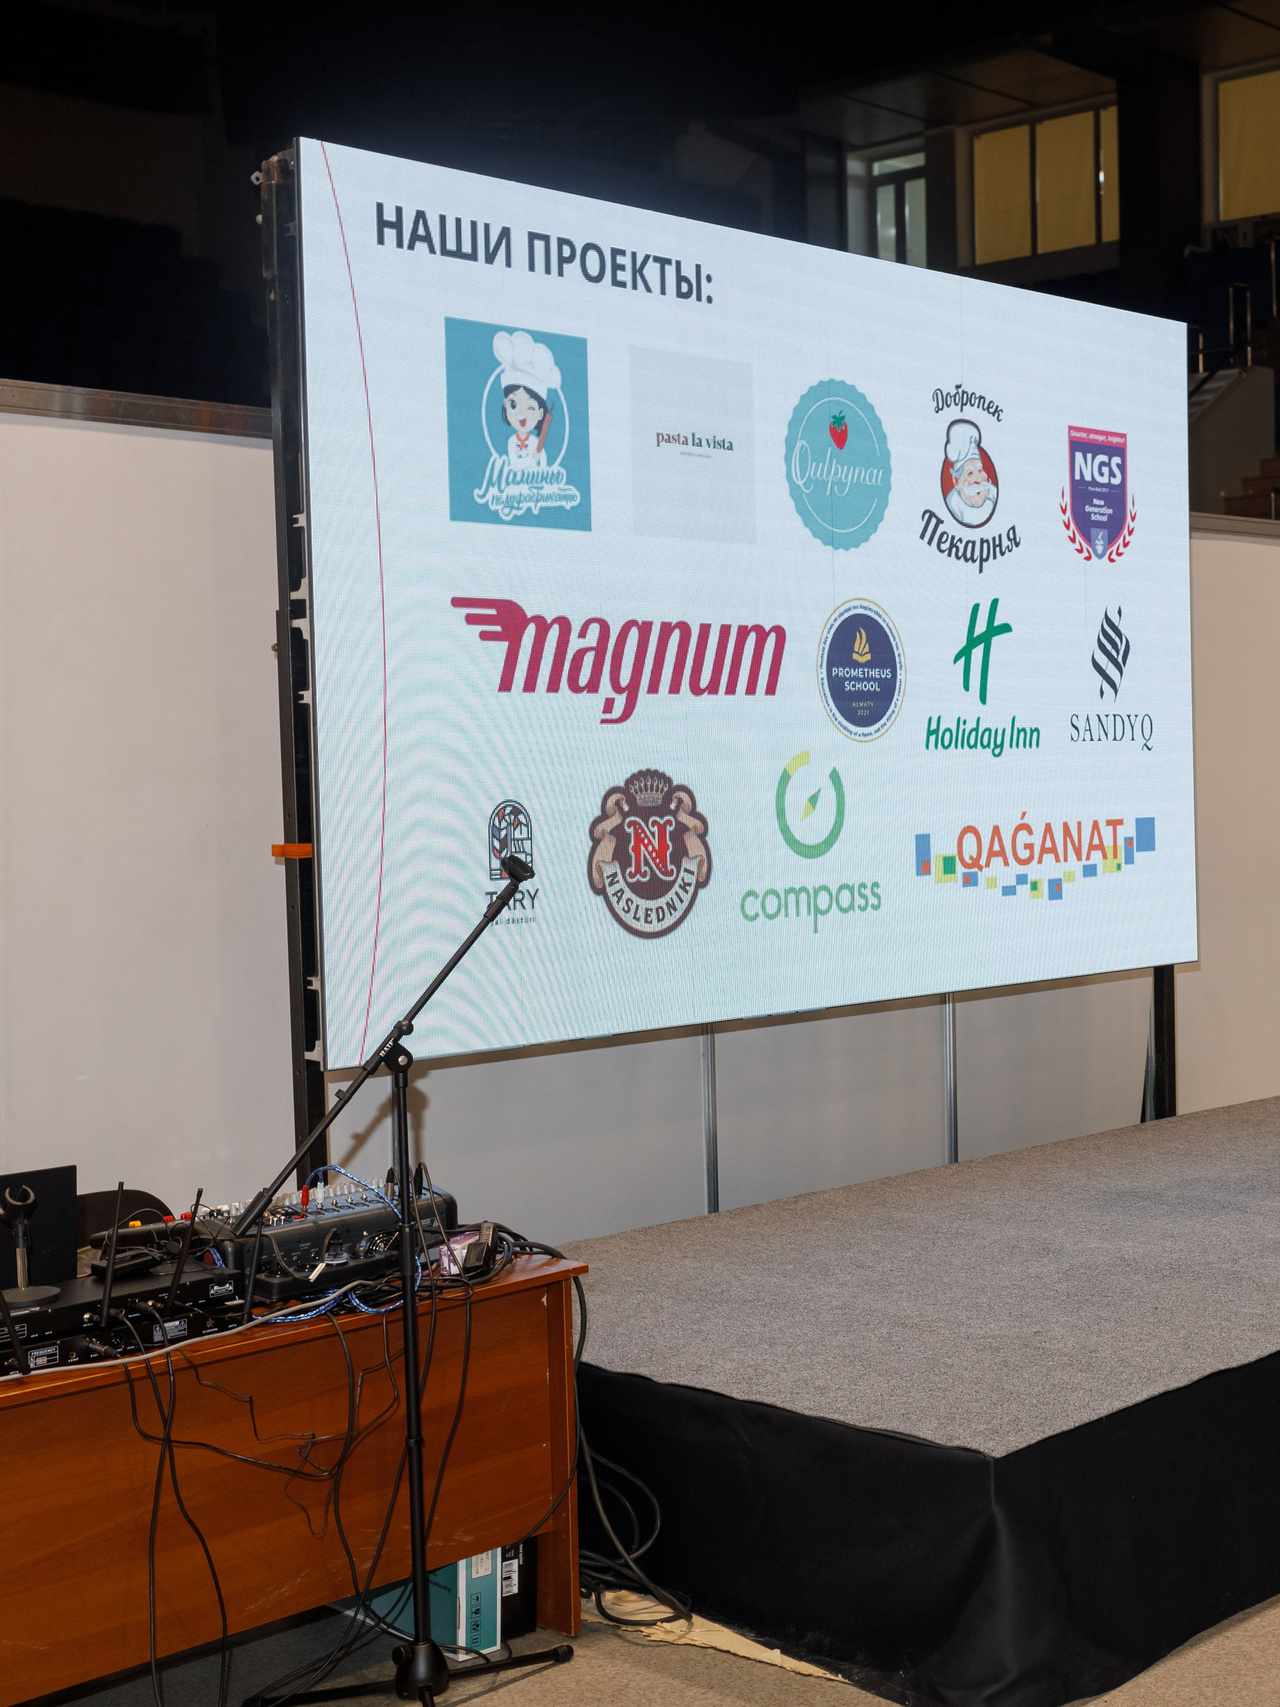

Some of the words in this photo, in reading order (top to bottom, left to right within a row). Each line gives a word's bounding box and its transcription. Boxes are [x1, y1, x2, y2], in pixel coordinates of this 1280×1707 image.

[375, 201, 512, 268] НАШИ
[527, 231, 713, 304] ПРОЕКТЫ:
[932, 384, 1004, 422] Добропек
[656, 432, 689, 447] pasta
[691, 432, 703, 447] la
[705, 435, 734, 451] vista
[1074, 451, 1122, 485] NGS
[919, 509, 1021, 574] Пекарня
[450, 596, 787, 724] magnum
[832, 667, 891, 679] PROMETHEUS
[844, 681, 880, 692] SCHOOL
[925, 715, 1007, 758] Holiday
[1009, 715, 1040, 750] Inn
[1069, 713, 1154, 751] SANDYQ
[957, 811, 1124, 872] QAǴANAT
[606, 867, 696, 925] NASLEDNIKI
[740, 880, 882, 934] compass
